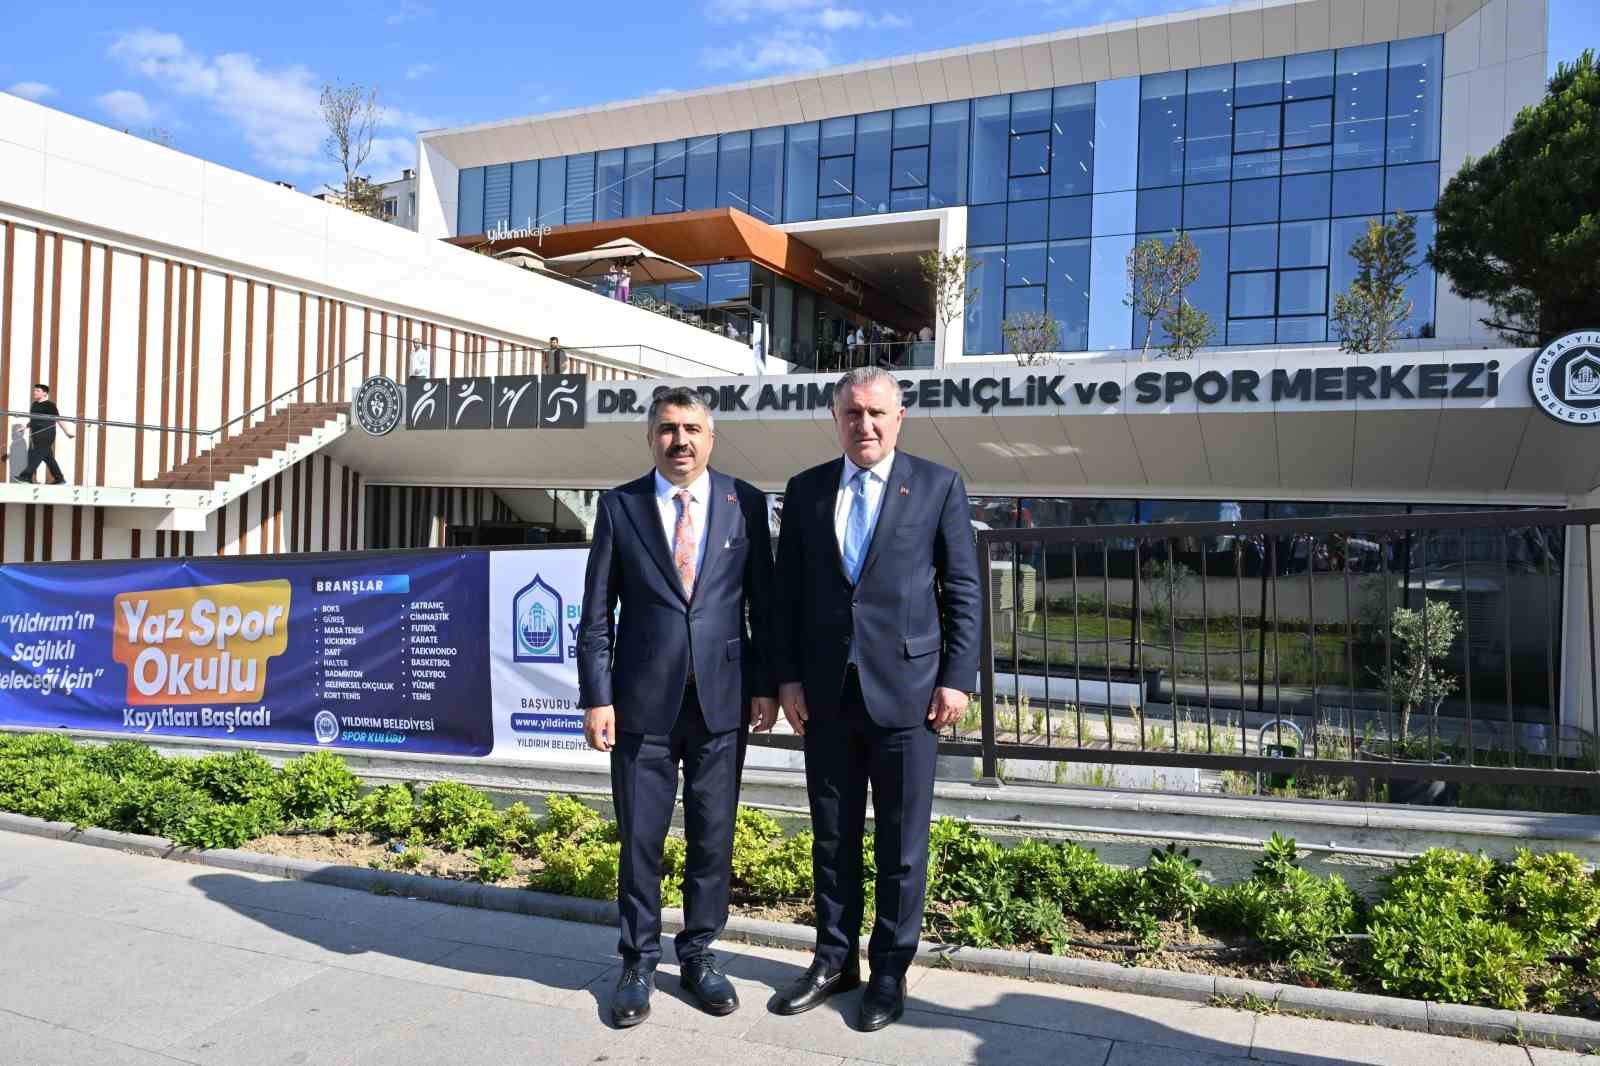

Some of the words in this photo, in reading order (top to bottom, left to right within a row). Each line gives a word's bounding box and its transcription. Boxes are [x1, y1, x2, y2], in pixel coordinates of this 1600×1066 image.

[1536, 343, 1566, 384] BURSA
[597, 388, 646, 414] DR.
[652, 384, 751, 411] DIK
[756, 382, 837, 411] AHM
[1074, 380, 1121, 404] ve
[1135, 370, 1261, 404] SPOR
[316, 579, 384, 595] BRANŞLAR
[410, 601, 445, 611] SATRANÇ
[120, 599, 184, 644] Yaz
[189, 598, 283, 650] Spor
[411, 624, 437, 632] FUTBOL
[410, 636, 439, 644] KARATE
[11, 639, 76, 668] Sağlıklı
[324, 648, 341, 656] DART
[411, 647, 458, 656] TAEKWONDO
[323, 659, 349, 667] HALTER
[411, 658, 451, 667] BASKETBOL
[133, 646, 257, 696] Okulu
[411, 670, 447, 679] VOLEYBOL
[0, 668, 60, 696] eleceği
[325, 680, 361, 689] GELENEKSEL
[361, 682, 395, 692] OKÇULUK
[411, 679, 436, 690] YÜZME
[521, 698, 570, 710] BAŞVURU
[122, 707, 198, 732] Kayıtları
[201, 706, 271, 733] Başladı
[341, 716, 381, 728] YILDIRIM
[383, 717, 434, 731] BELEDİYESİ
[515, 717, 584, 729] www.yildirimb
[342, 731, 367, 742] SPOR
[517, 738, 549, 748] YILDIRIM
[551, 738, 592, 751] BELEDİYE
